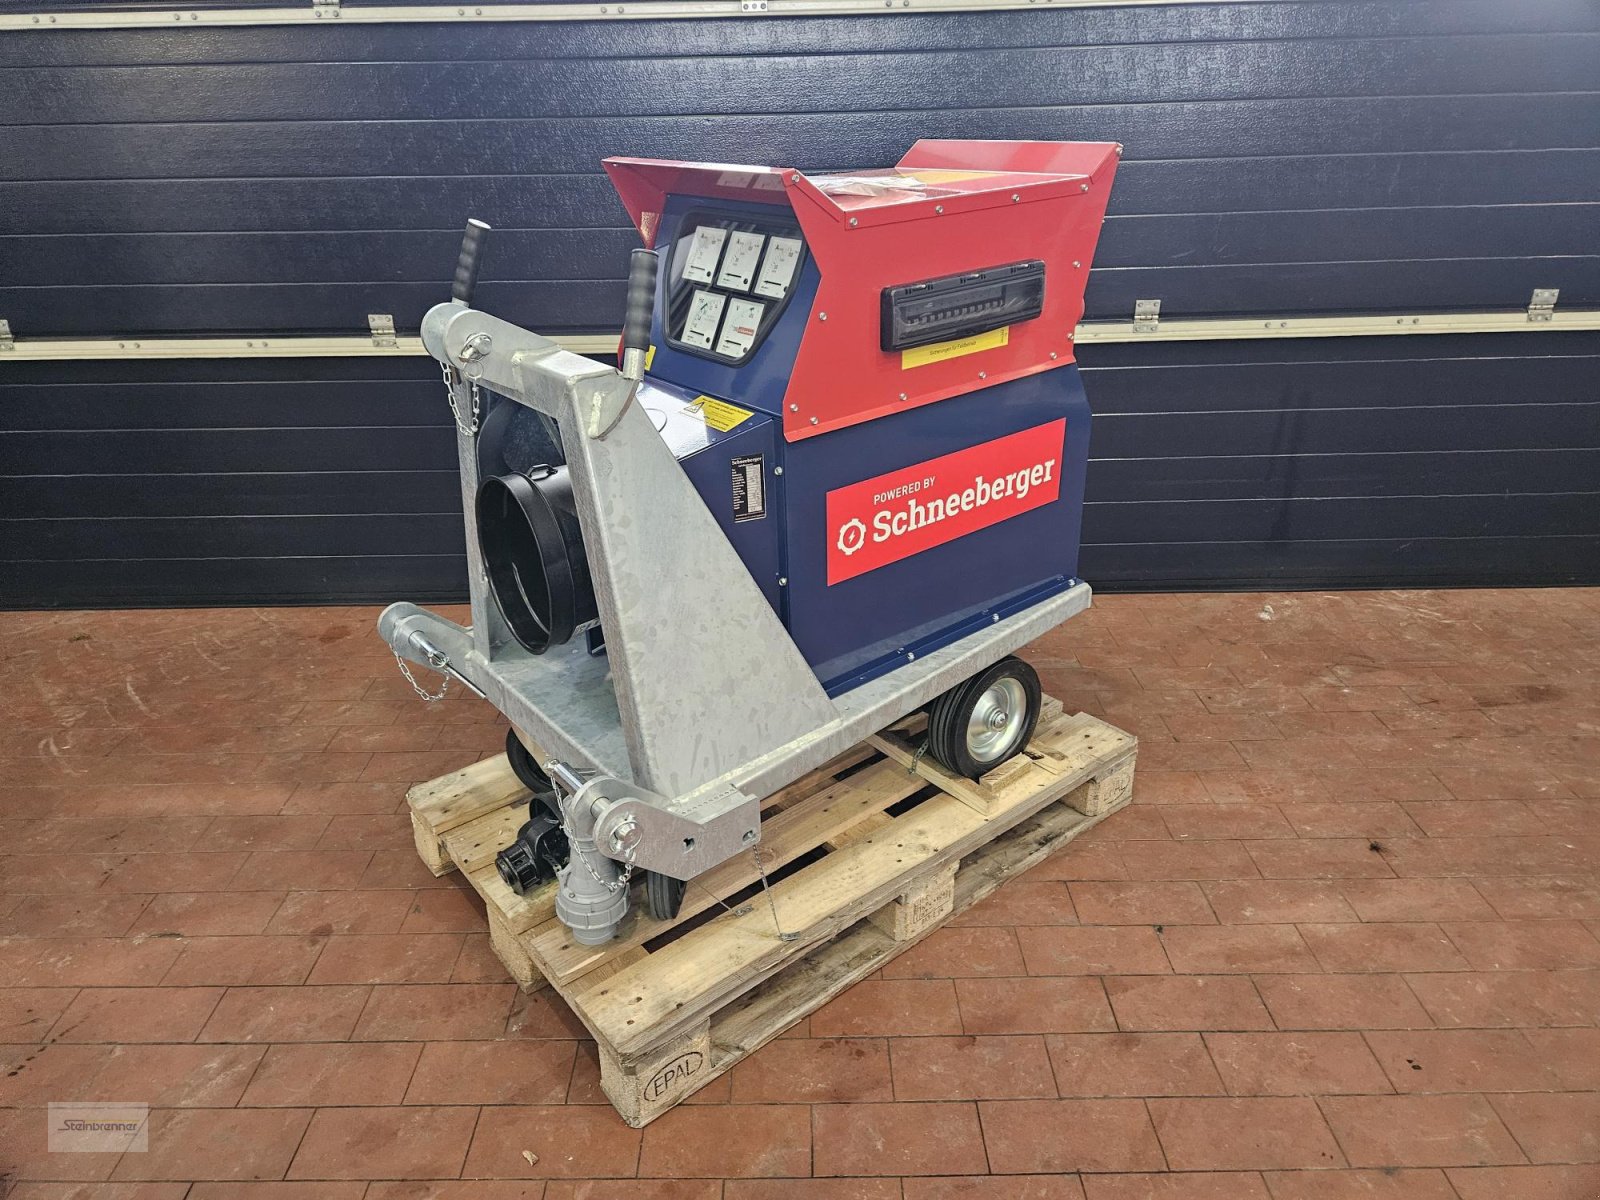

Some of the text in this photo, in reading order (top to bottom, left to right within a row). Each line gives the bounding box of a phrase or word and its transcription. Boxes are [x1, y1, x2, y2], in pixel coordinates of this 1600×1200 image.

[731, 457, 762, 466] Schneeberger
[872, 458, 1055, 544] Schneeberger
[873, 475, 936, 506] POWERED BY
[653, 1059, 697, 1097] EPAL
